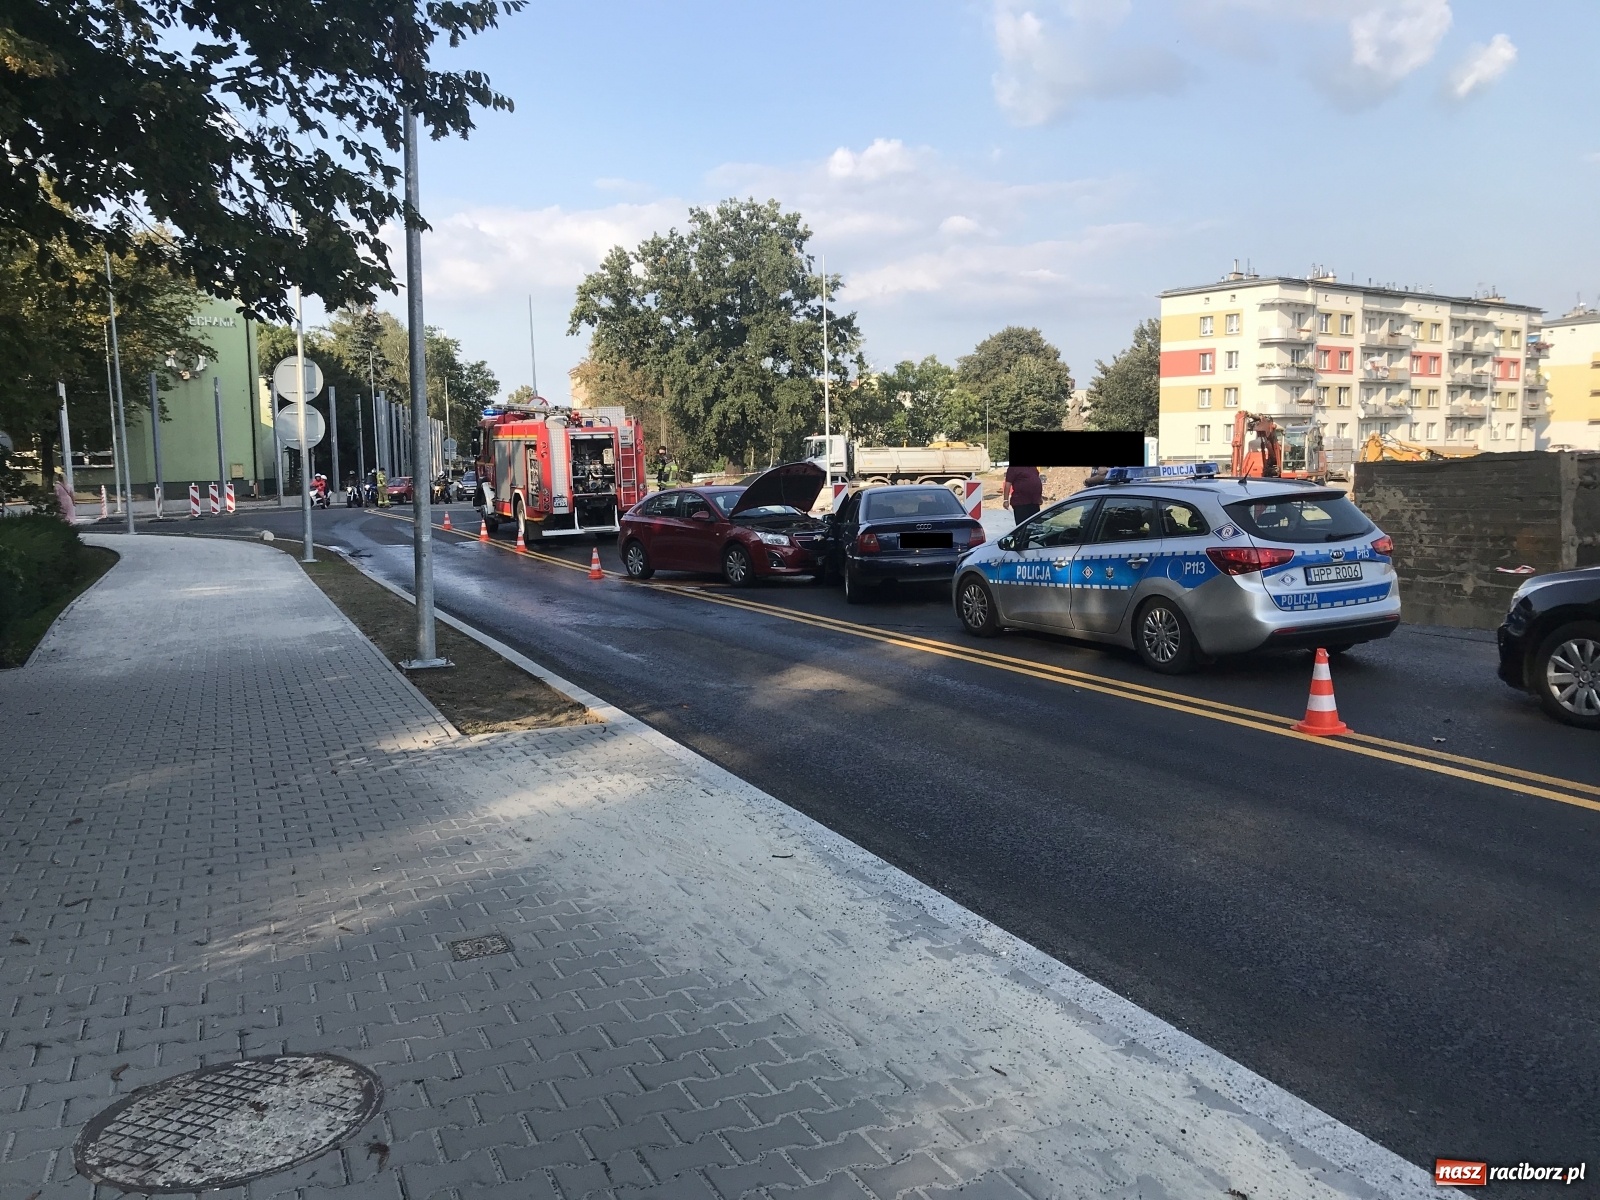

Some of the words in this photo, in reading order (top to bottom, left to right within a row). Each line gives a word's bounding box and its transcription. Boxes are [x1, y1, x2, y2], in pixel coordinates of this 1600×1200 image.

[184, 315, 236, 327] ECHANIK
[1162, 465, 1195, 476] POLICJA
[1356, 549, 1370, 560] P113
[1016, 565, 1051, 580] POLICJA
[1184, 561, 1206, 575] P113
[1312, 567, 1332, 582] HPP
[1335, 565, 1359, 580] R006
[1281, 593, 1318, 606] POLICJA
